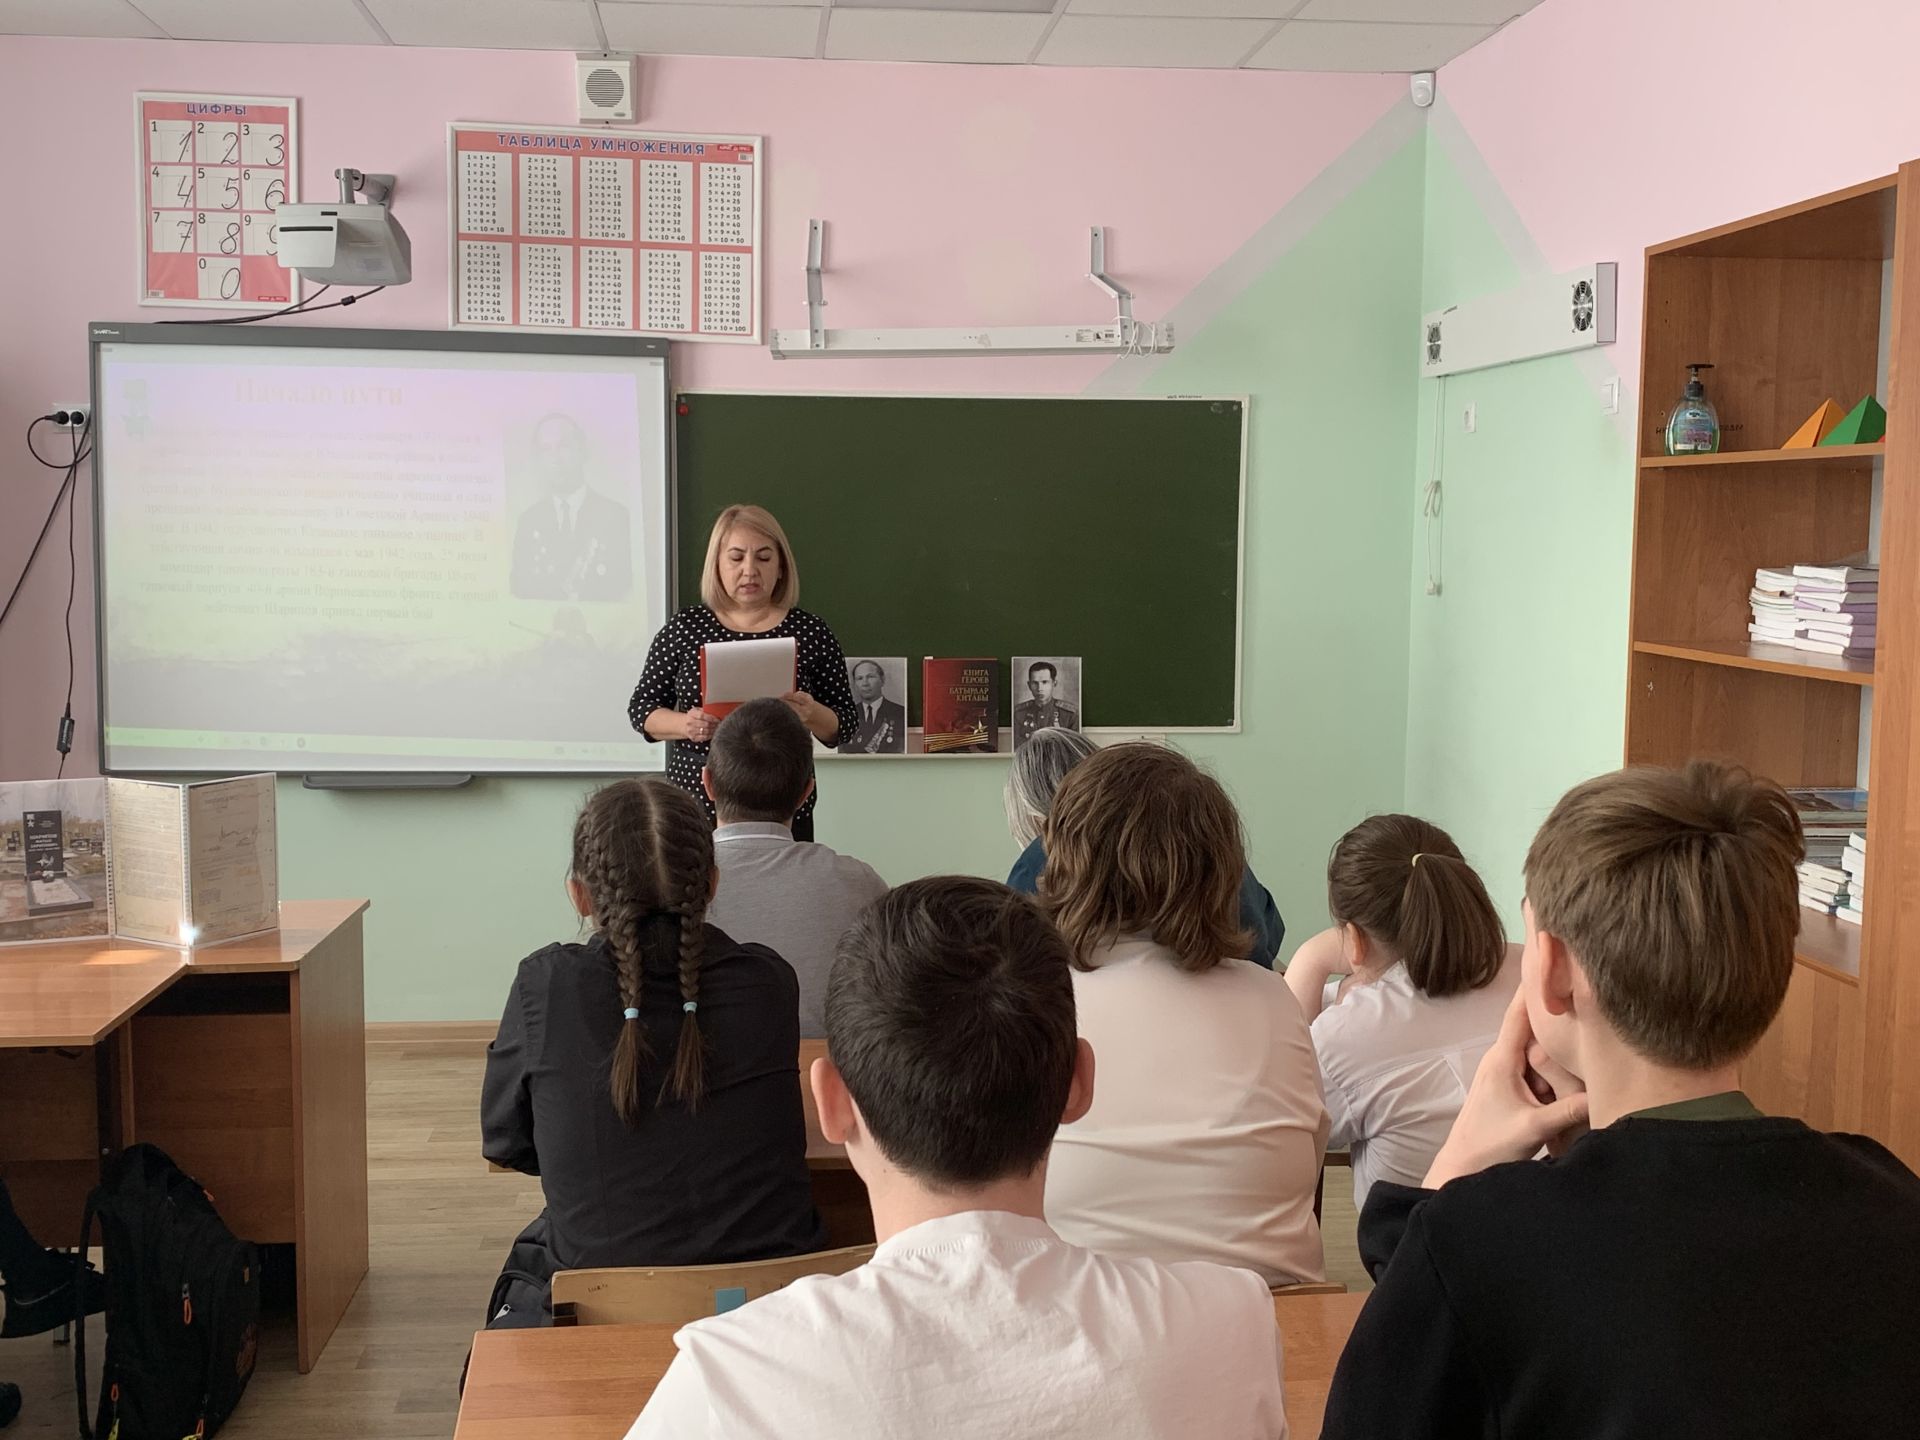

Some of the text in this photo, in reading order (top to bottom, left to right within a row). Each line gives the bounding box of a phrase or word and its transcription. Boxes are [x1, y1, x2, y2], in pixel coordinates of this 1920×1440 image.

[186, 103, 246, 115] ЦИФРЫ
[151, 121, 157, 132] 1
[197, 123, 204, 134] 2
[243, 125, 250, 135] 3
[179, 130, 193, 163] 1
[221, 131, 239, 165] 2
[265, 133, 285, 167] 3
[497, 134, 582, 151] ТАБЛИЦА
[591, 137, 705, 155] УМНОЖЕНИЯ
[152, 168, 160, 177] 4
[198, 168, 205, 179] 5
[243, 169, 250, 180] 6
[177, 175, 194, 208] 4
[221, 177, 240, 210] 5
[264, 179, 286, 212] 6
[154, 212, 160, 222] 7
[198, 213, 206, 224] 8
[244, 215, 251, 226] 9
[176, 220, 194, 253] 7
[220, 222, 241, 255] 8
[198, 258, 207, 269] 0
[220, 267, 241, 300] 0
[342, 388, 403, 412] пути
[961, 676, 990, 684] ГЕРОЕВ
[956, 694, 989, 702] КИТАБЫ
